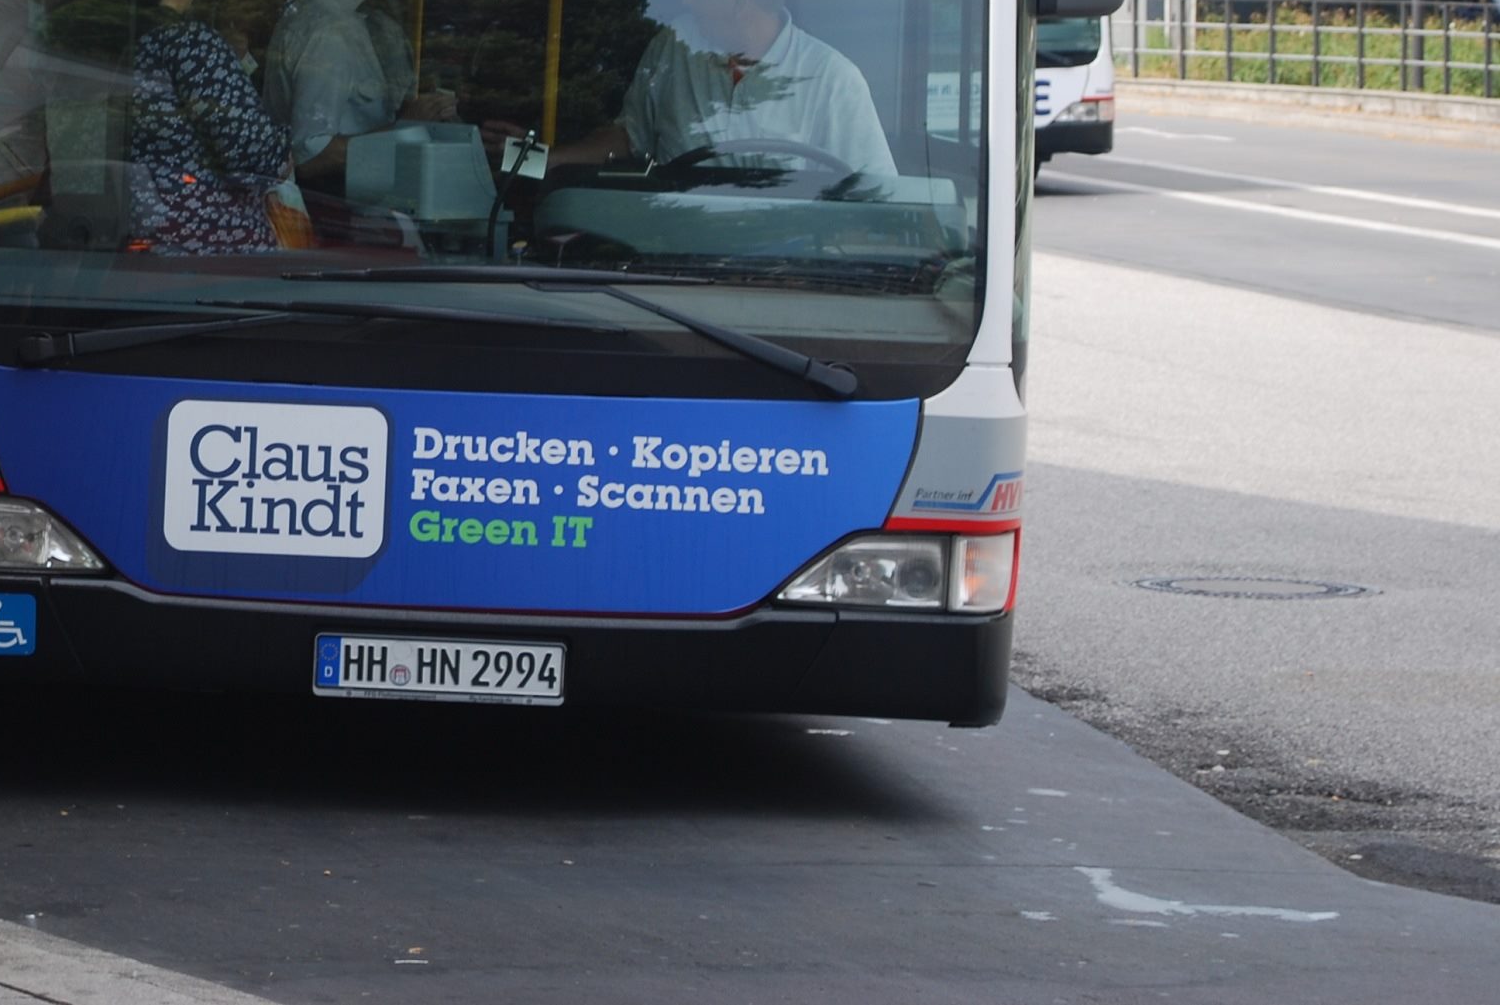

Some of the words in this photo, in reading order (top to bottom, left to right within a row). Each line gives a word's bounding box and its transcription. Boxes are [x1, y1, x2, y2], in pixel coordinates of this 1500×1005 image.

[189, 424, 370, 484] Claus
[413, 427, 595, 467] Drucken
[632, 436, 829, 478] Kopieren
[190, 477, 365, 540] Kindt
[411, 468, 540, 506] Faxen
[576, 475, 765, 515] Scannen
[916, 487, 954, 500] Partner
[409, 510, 538, 547] Green
[551, 516, 593, 549] IT
[323, 666, 333, 678] D
[343, 644, 388, 683] HH
[416, 647, 461, 686] HN
[470, 649, 557, 690] 2994
